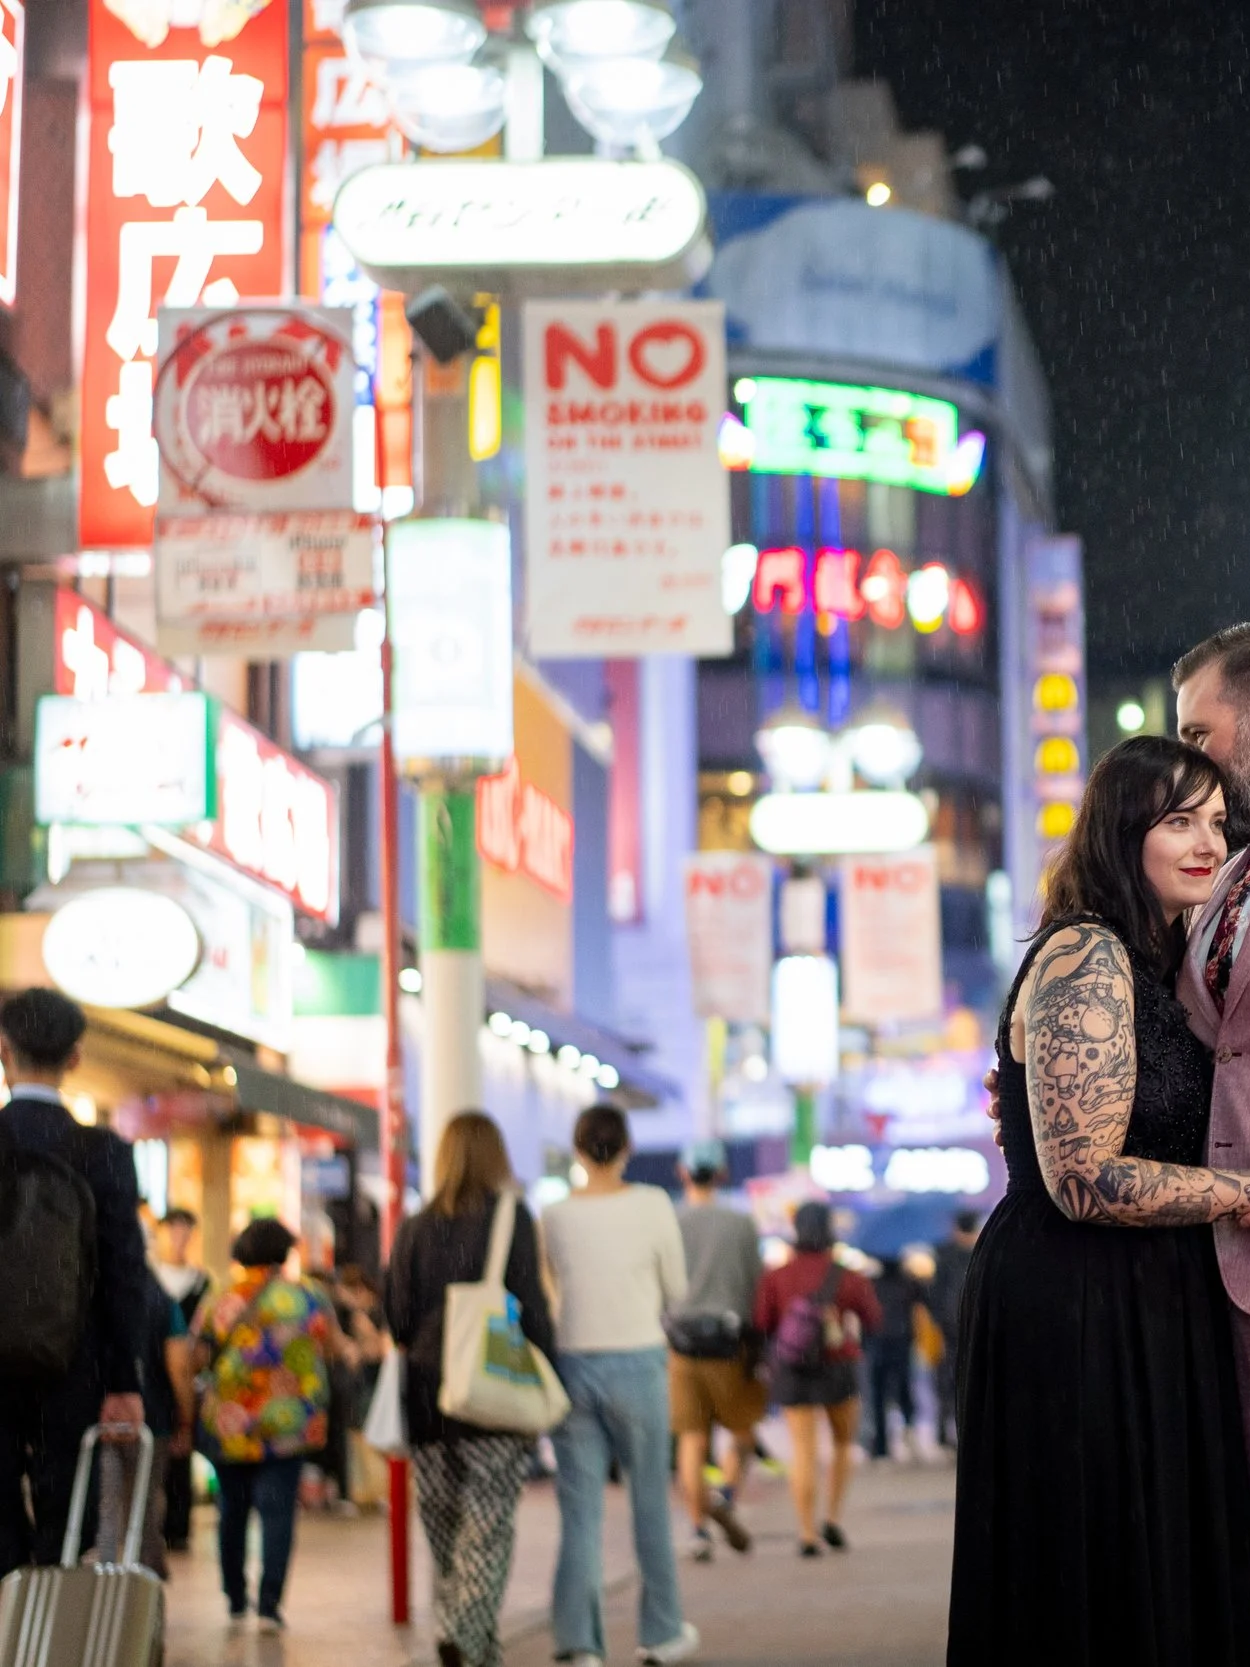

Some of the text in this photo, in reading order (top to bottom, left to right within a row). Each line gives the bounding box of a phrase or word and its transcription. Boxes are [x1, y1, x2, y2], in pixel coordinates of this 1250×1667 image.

[545, 322, 707, 390] NO
[199, 378, 327, 444] 消火栓
[546, 402, 708, 425] SMOKING
